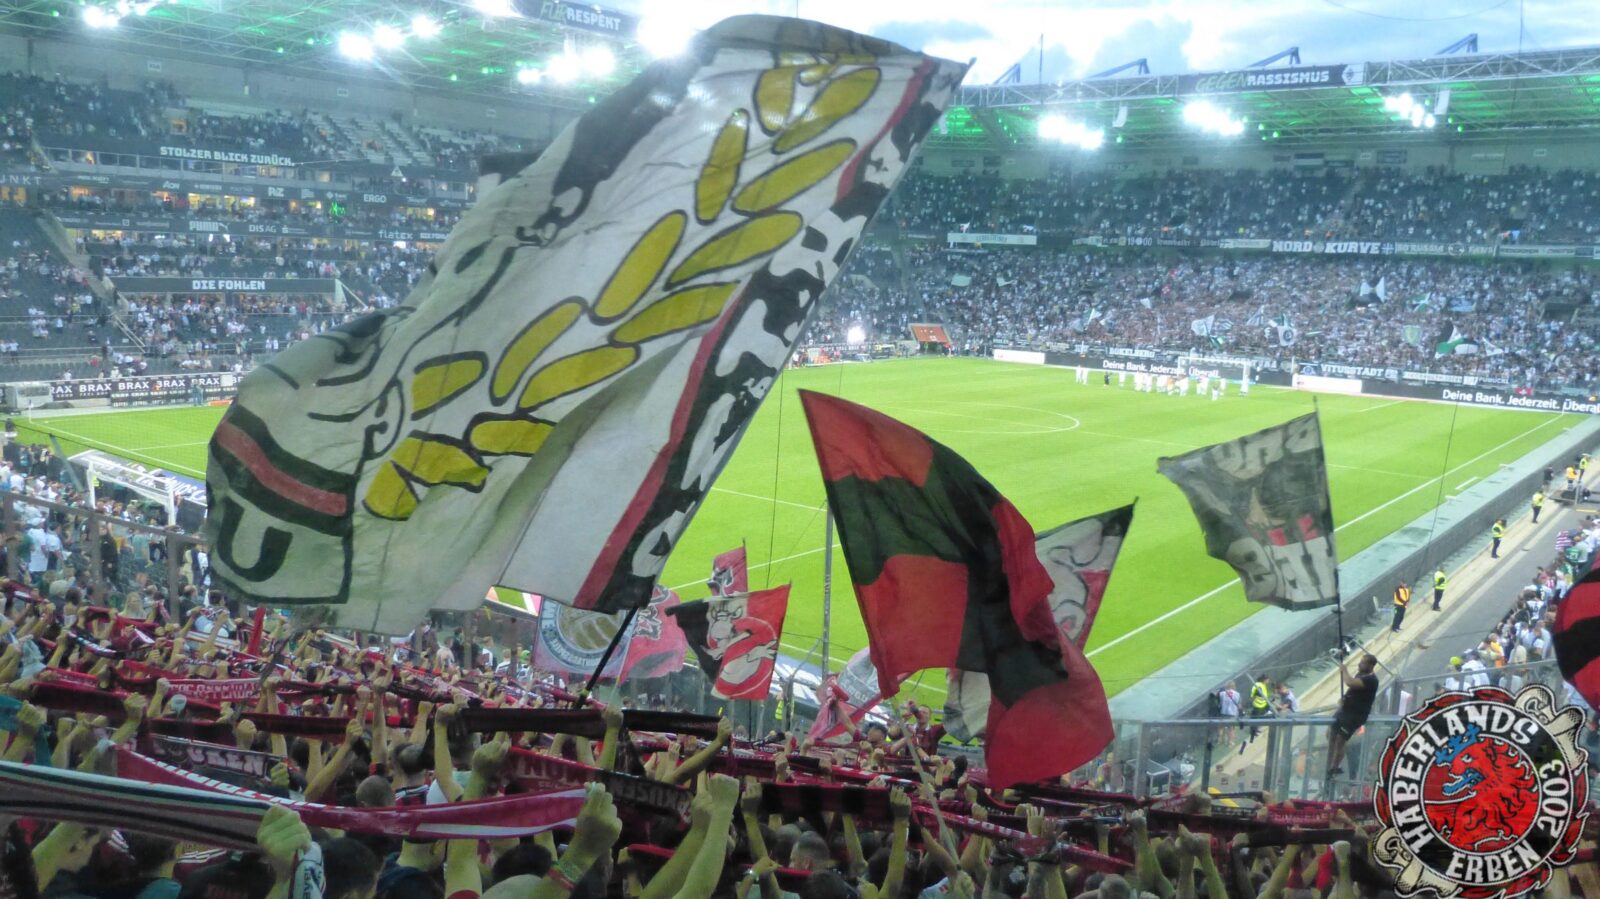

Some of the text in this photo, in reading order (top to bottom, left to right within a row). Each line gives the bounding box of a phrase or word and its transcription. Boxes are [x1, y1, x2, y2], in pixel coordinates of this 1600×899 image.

[568, 7, 621, 30] RESPEKT
[1249, 71, 1329, 86] RASSISMUS
[160, 146, 296, 166] STOLZER BLICK ZURÜCK.
[363, 194, 388, 203] ERGO
[1272, 241, 1314, 253] NORD
[1324, 242, 1382, 254] KURVE
[192, 279, 266, 290] DIE FOHLEN
[1103, 360, 1125, 370] Deine
[1126, 361, 1147, 371] Bank.
[79, 383, 112, 393] BRAX
[118, 381, 150, 391] BRAX
[1442, 389, 1473, 402] Deine
[1475, 392, 1505, 405] Bank.
[1507, 395, 1560, 410] Jederzeit.
